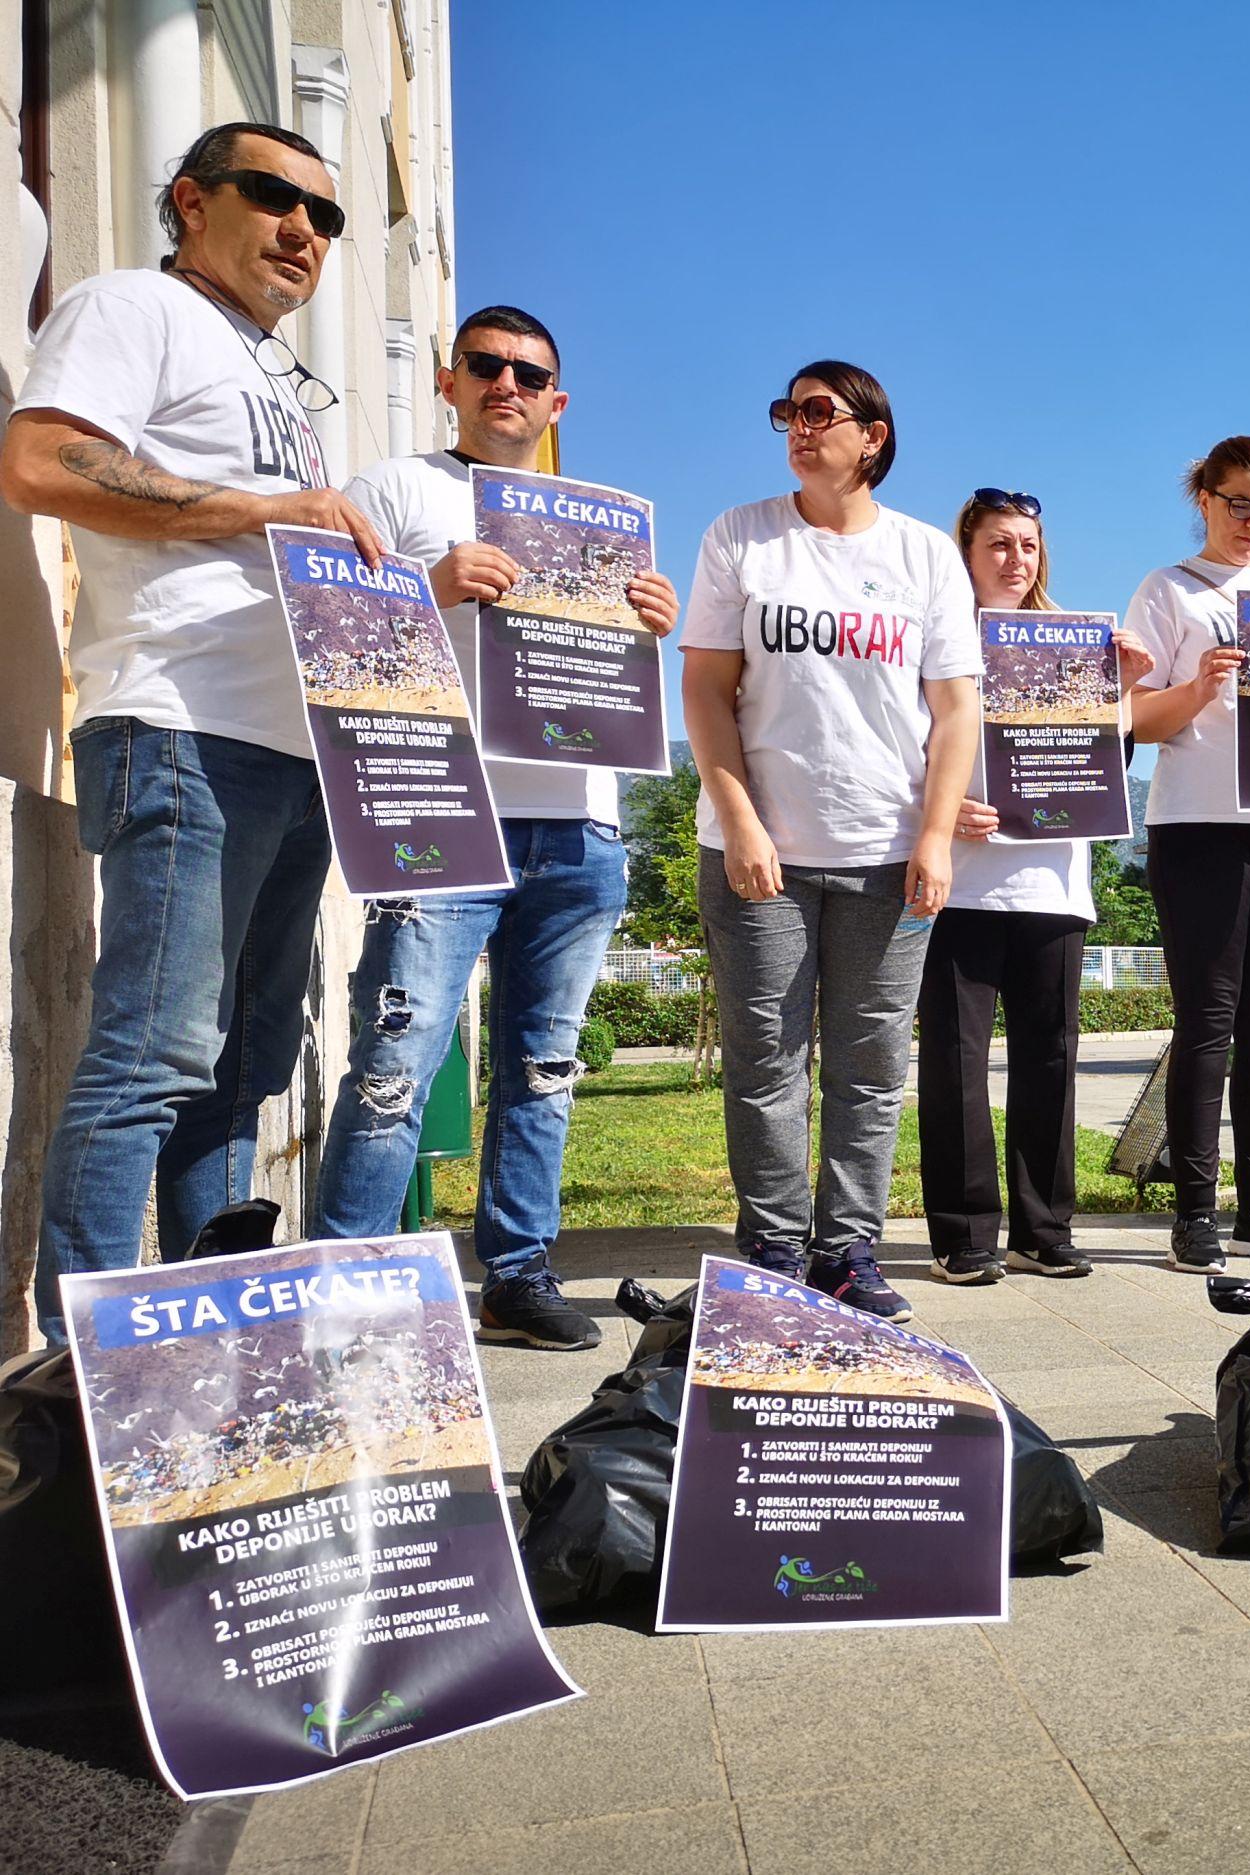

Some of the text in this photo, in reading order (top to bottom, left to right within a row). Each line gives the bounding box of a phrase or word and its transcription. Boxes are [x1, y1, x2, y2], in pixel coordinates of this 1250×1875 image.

[502, 485, 640, 533] ŠTA ČEKATE?
[307, 548, 421, 599] ŠTA ČEKATE?
[507, 617, 635, 644] KAKO RIJEŠITI PROBLEM
[522, 630, 626, 654] DEPONIJE UBORAK?
[761, 605, 909, 667] UBORAK
[999, 623, 1102, 644] ŠTA ČEKATE?
[339, 717, 371, 729] KAKO
[411, 721, 453, 735] PROBLEM
[356, 732, 405, 745] DEPONIJE
[1003, 729, 1027, 738] KAKO
[1029, 727, 1061, 737] RIJEŠITI
[1015, 738, 1092, 746] DEPONIJE UBORAK?
[743, 1274, 808, 1303] ŠTA
[130, 1267, 420, 1337] ŠTA ČEKATE?
[733, 1397, 955, 1416] KAKO RIJEŠITI PROBLEM
[755, 1413, 939, 1429] DEPONIJE UBORAK?
[741, 1441, 932, 1459] 1. ZATVORITI I SANIRATI DEPONIJU
[762, 1450, 922, 1463] UBORAK U ŠTO KRAĆEM ROKU!
[737, 1466, 960, 1486] 2. IZNAĆI NOVU LOKACIJU ZA DEPONIJU!
[178, 1480, 451, 1552] KAKO RIJEŠITI PROBLEM
[734, 1495, 939, 1517] 3. OBRISATI POSTOJEĆU DEPONIJU IZ
[756, 1509, 964, 1521] PROSTORNOG PLANA GRADA MOSTARA
[216, 1504, 436, 1564] DEPONIJE UBORAK?
[754, 1521, 820, 1532] I KANTONA!
[209, 1590, 233, 1611] 1.
[236, 1565, 310, 1593] ZATVORITI
[312, 1564, 318, 1573] I
[383, 1542, 438, 1560] DEPONIJU
[239, 1582, 299, 1606] UBORAK
[301, 1580, 310, 1589] U
[315, 1573, 340, 1587] ŠTO
[396, 1556, 431, 1570] ROKU!
[214, 1575, 474, 1643] 2. IZNAĆI NOVU LOKACIJU ZA DEPONIJU!
[353, 1630, 393, 1646] PLANA
[394, 1623, 434, 1639] GRADA
[435, 1612, 490, 1632] MOSTARA
[223, 1658, 248, 1680] 3.
[251, 1633, 317, 1660] OBRISATI
[392, 1608, 446, 1626] DEPONIJU
[448, 1604, 460, 1616] IZ
[257, 1654, 341, 1688] I KANTONA
